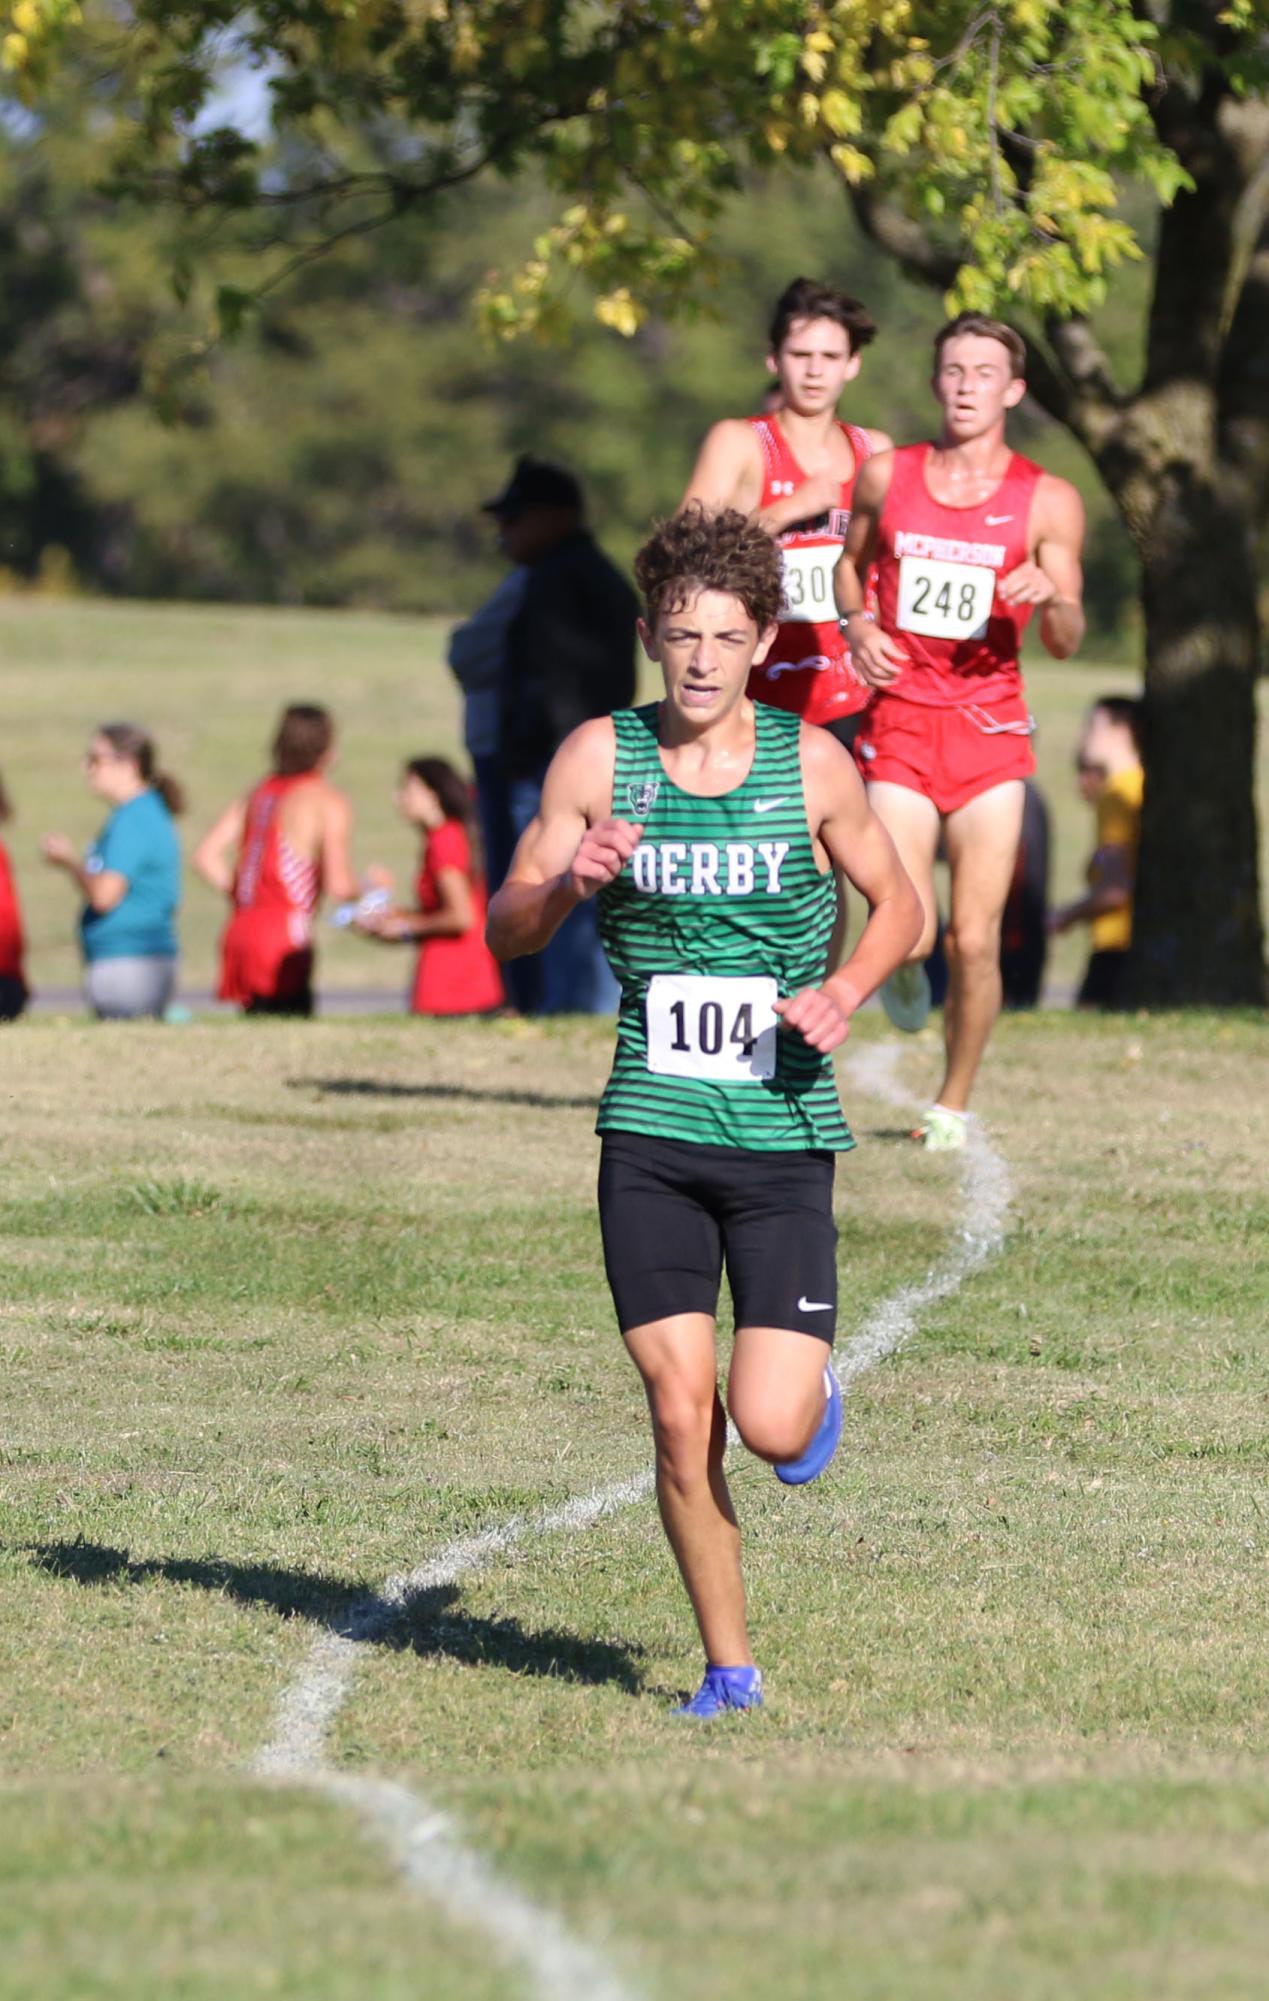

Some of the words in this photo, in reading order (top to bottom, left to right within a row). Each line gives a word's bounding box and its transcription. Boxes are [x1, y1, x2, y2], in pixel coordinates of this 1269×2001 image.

[788, 565, 826, 606] 30
[911, 575, 976, 622] 248
[632, 841, 790, 897] DERBY
[669, 1000, 758, 1057] 104
